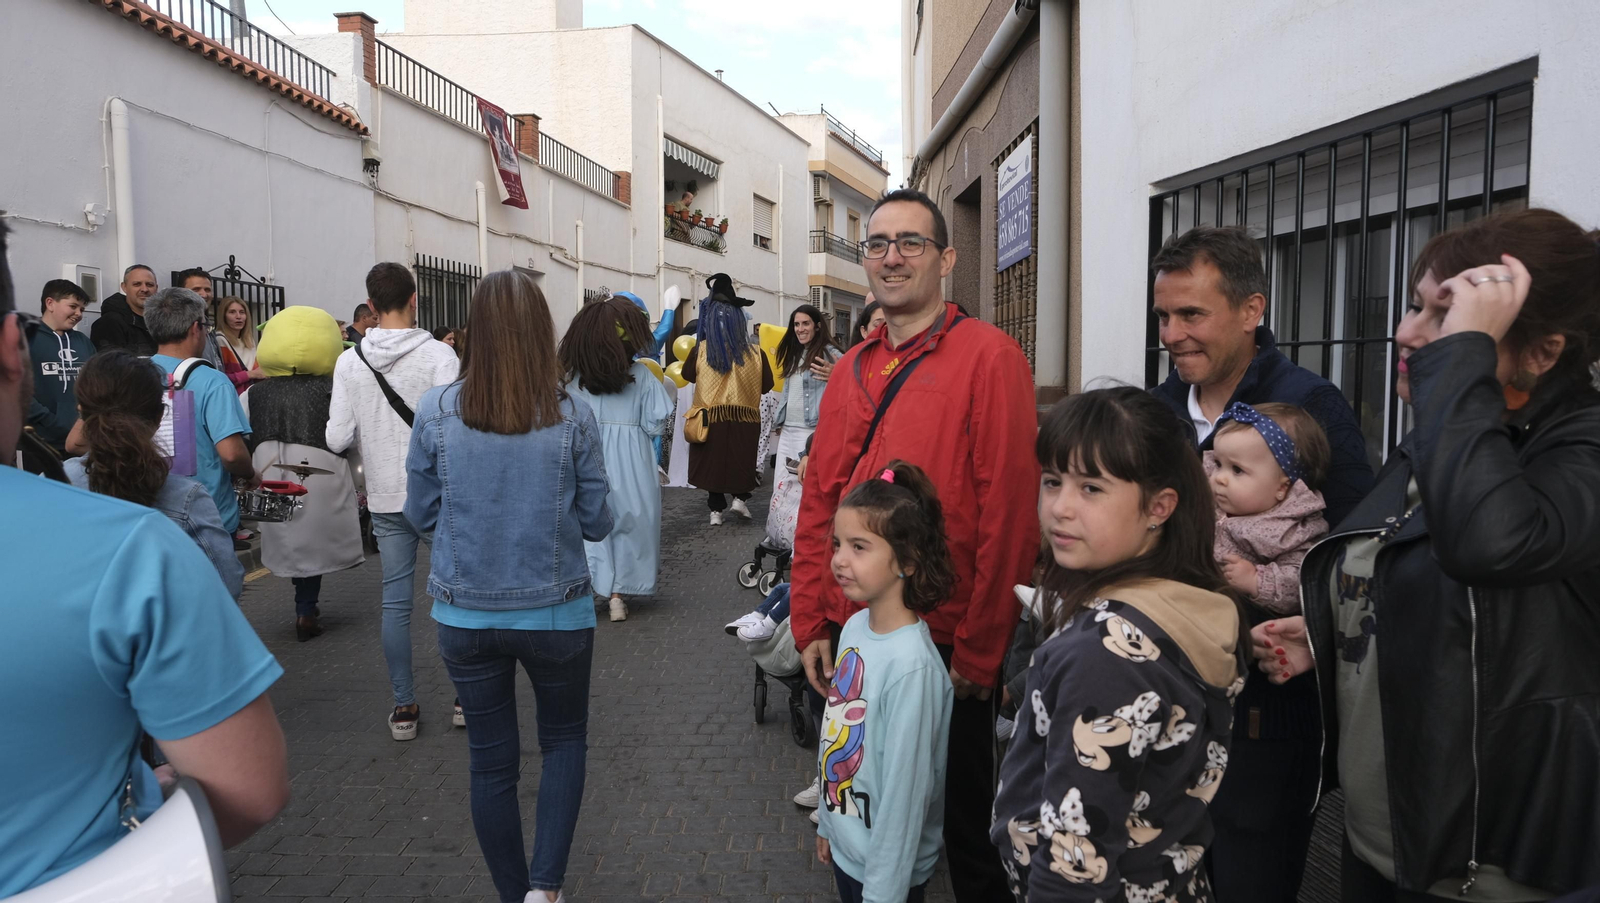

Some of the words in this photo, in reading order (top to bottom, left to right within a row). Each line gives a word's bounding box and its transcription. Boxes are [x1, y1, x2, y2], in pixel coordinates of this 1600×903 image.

[999, 200, 1006, 220] SE
[1007, 180, 1029, 212] VENDE
[1018, 204, 1029, 236] 715
[396, 723, 414, 731] adidas
